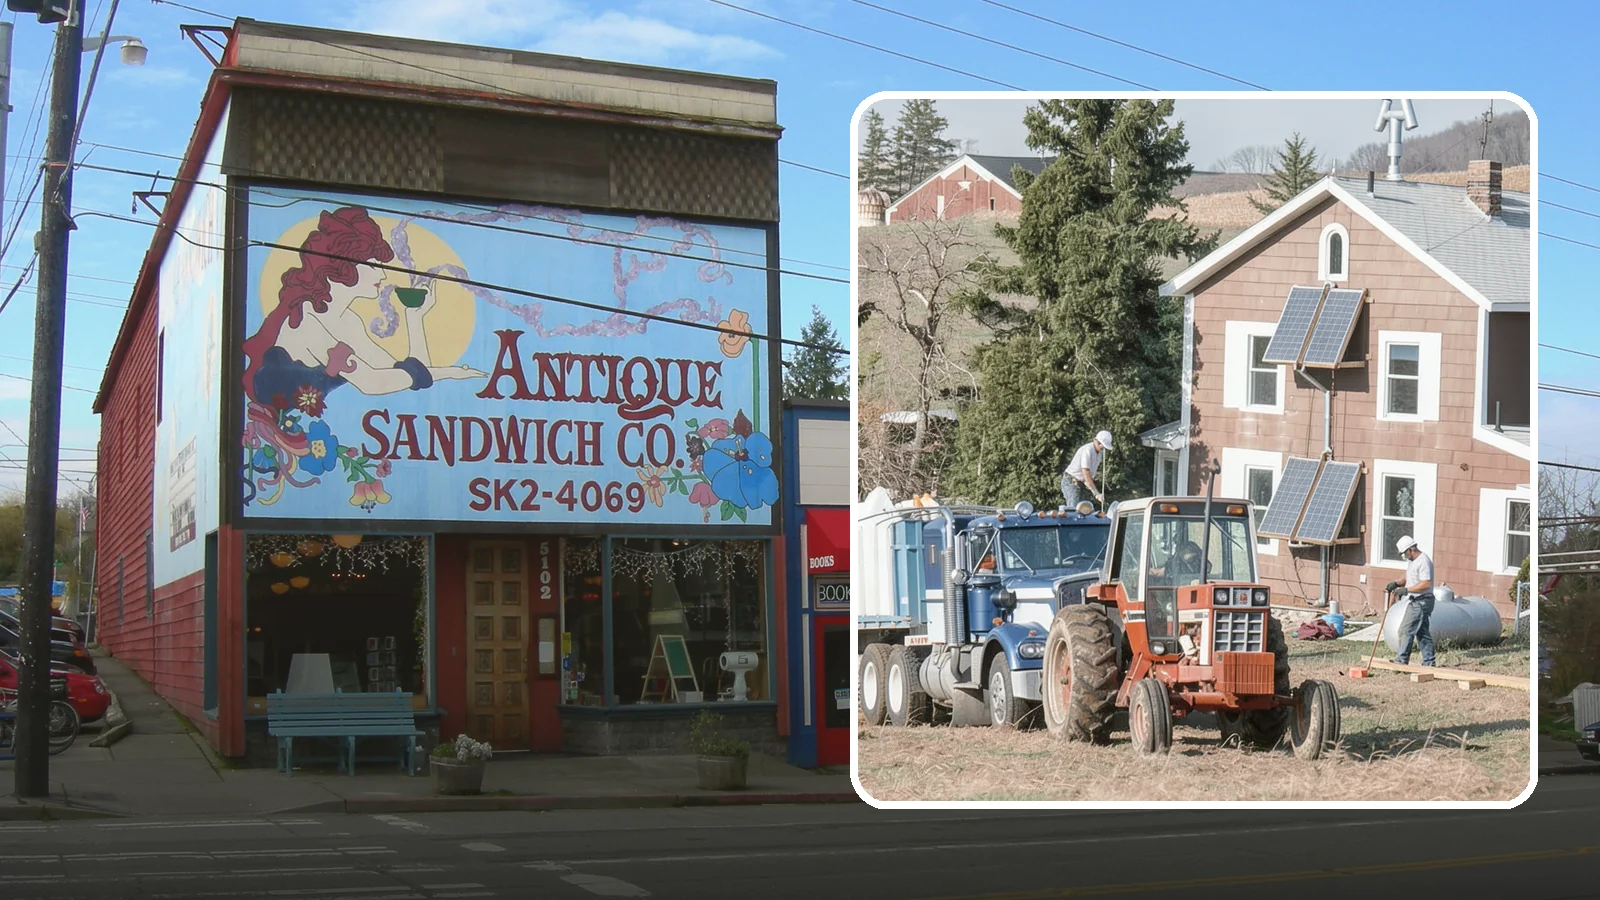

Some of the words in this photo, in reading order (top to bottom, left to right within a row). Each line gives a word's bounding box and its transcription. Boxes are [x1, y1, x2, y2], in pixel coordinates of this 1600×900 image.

[476, 329, 724, 421] ANTIQUE
[361, 408, 605, 468] SANDWICH
[616, 420, 685, 469] CO.
[468, 476, 647, 513] SK2-4069
[540, 541, 552, 600] 5102
[809, 555, 835, 569] BOOKS
